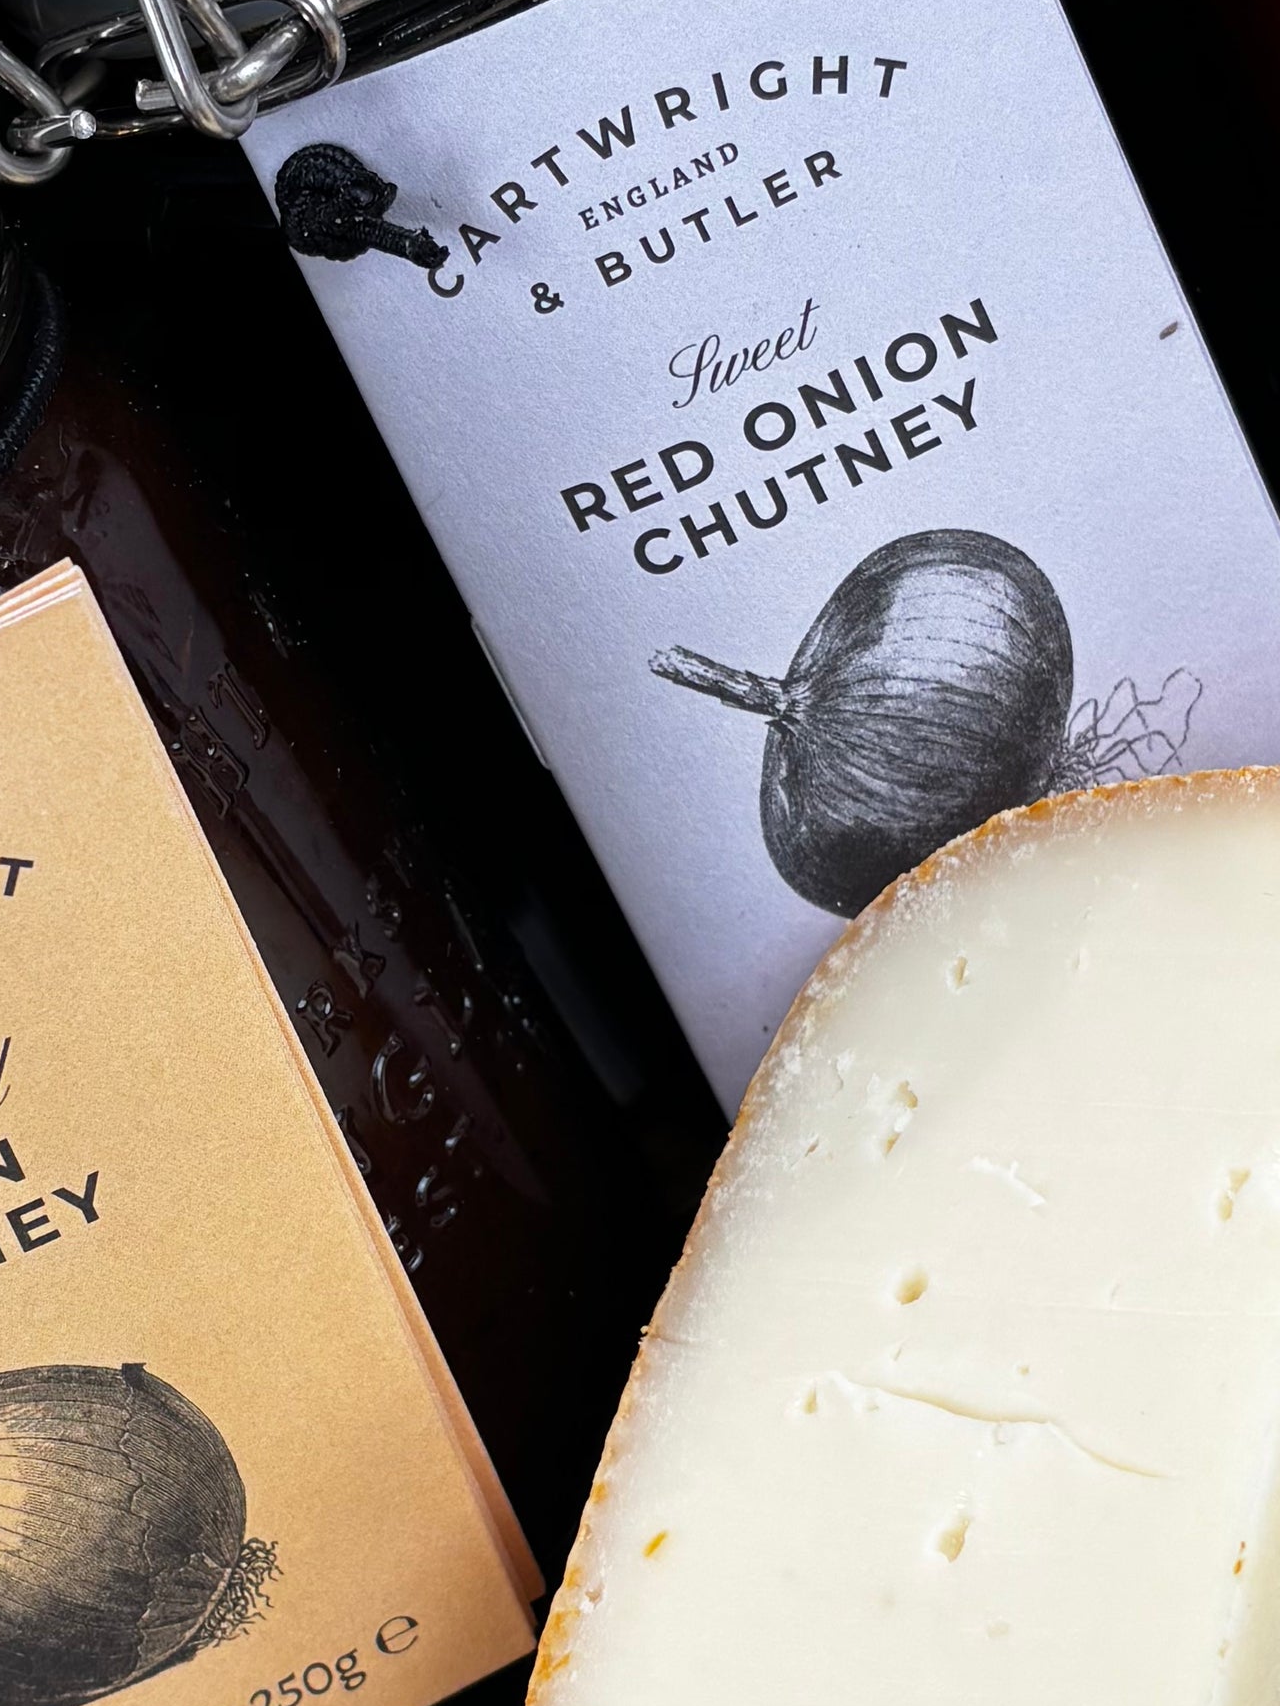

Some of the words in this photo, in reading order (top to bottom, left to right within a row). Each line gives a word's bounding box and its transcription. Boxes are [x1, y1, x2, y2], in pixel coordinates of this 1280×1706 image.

[427, 55, 908, 299] CARTWRIGHT
[531, 283, 564, 314] &
[595, 151, 842, 287] BUTLER
[579, 143, 738, 230] ENGLAND
[560, 441, 713, 532] RED
[744, 299, 997, 450] ONION
[668, 297, 821, 409] Sweet
[634, 379, 977, 574] CHUTNEY
